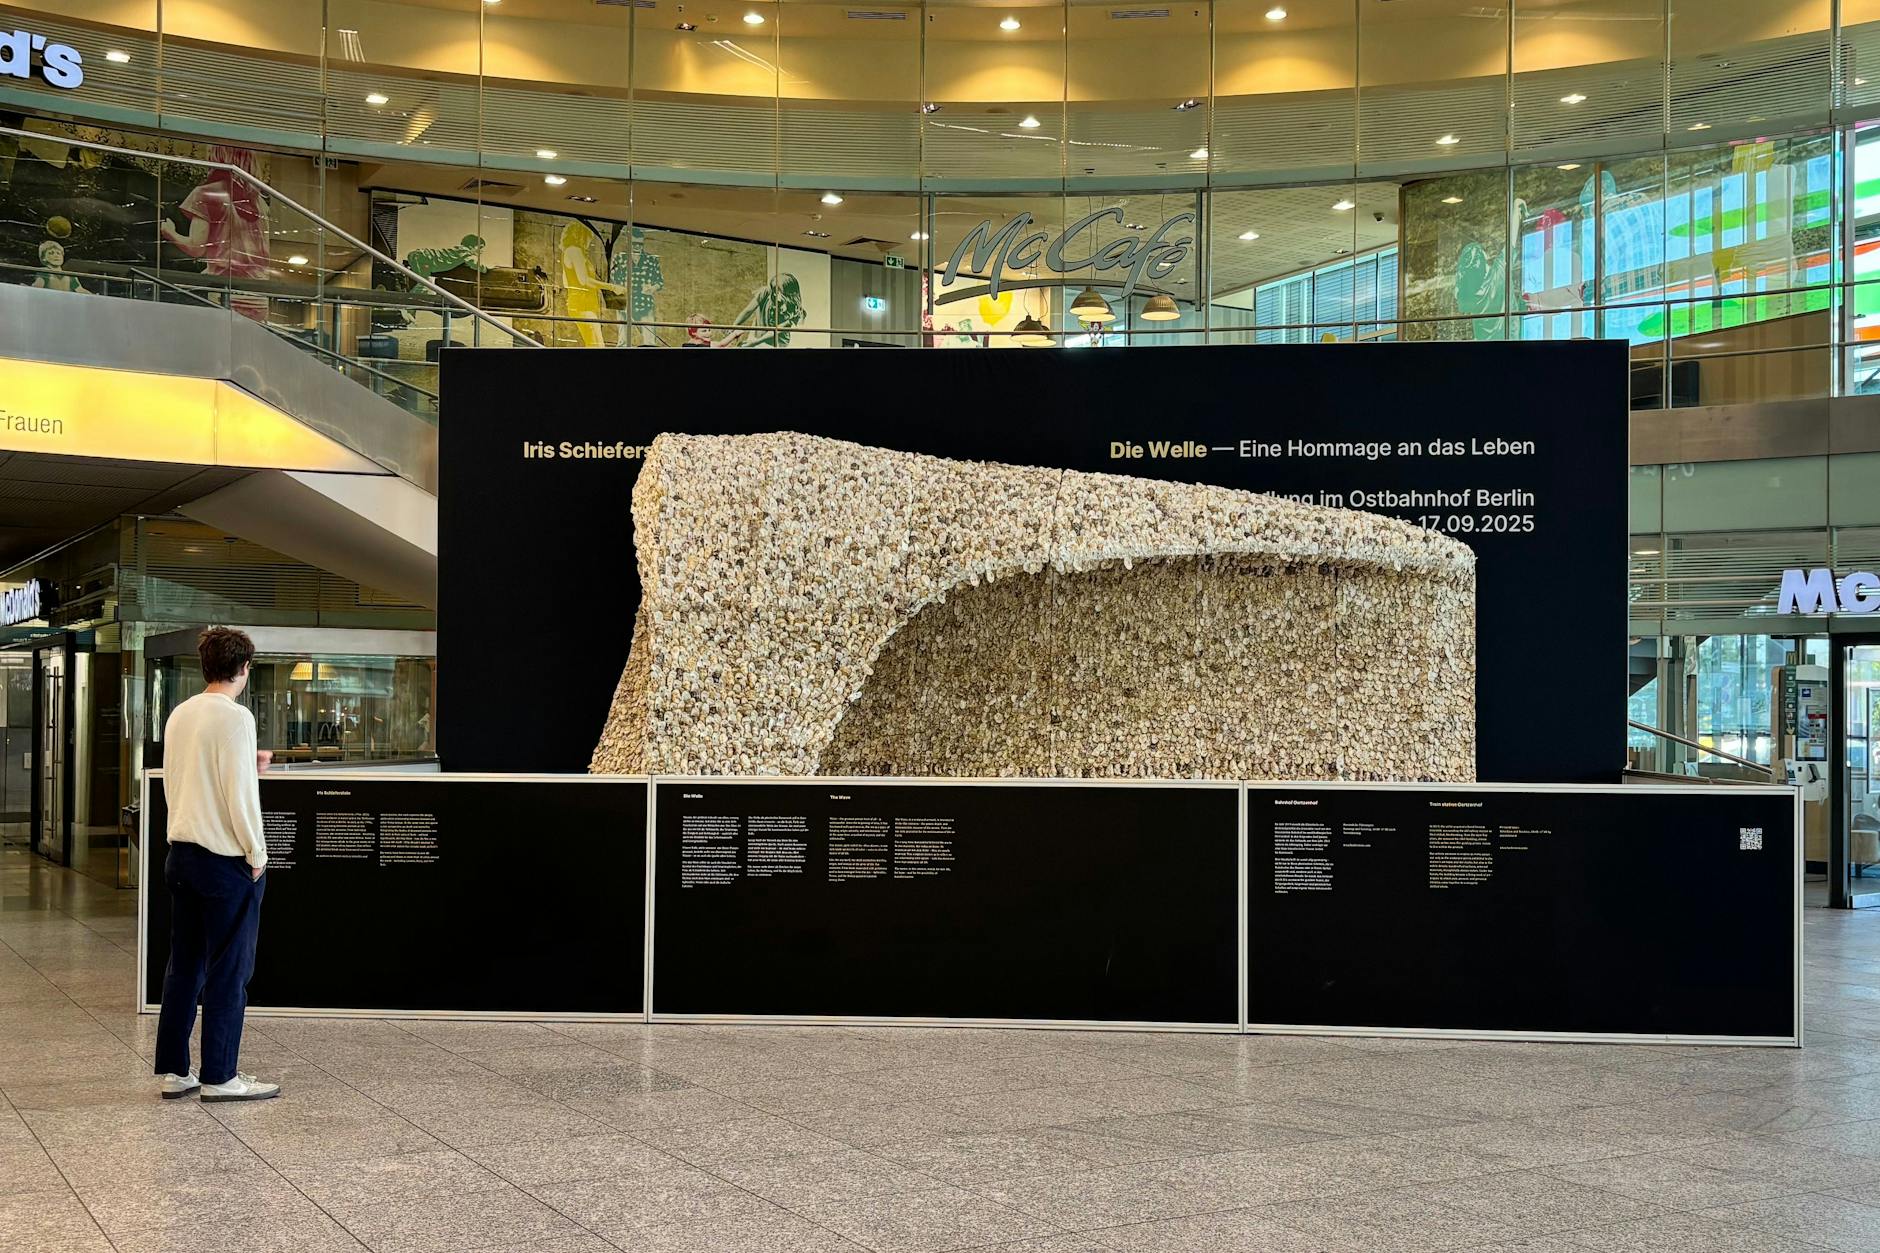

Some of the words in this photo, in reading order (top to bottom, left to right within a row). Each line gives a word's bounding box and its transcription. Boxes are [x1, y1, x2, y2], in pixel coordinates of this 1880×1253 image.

[0, 30, 84, 89] d's
[523, 440, 555, 459] Iris
[1110, 440, 1144, 459] Die
[1147, 440, 1208, 459] Welle
[1239, 438, 1282, 458] Eine
[1287, 439, 1392, 462] Hommage
[1397, 442, 1422, 456] an
[1427, 437, 1466, 456] das
[1471, 437, 1535, 456] Leben
[1319, 489, 1344, 508] im
[1349, 488, 1470, 508] Ostbahnhof
[1477, 488, 1535, 507] Berlin
[1418, 514, 1535, 534] 17.09.2025
